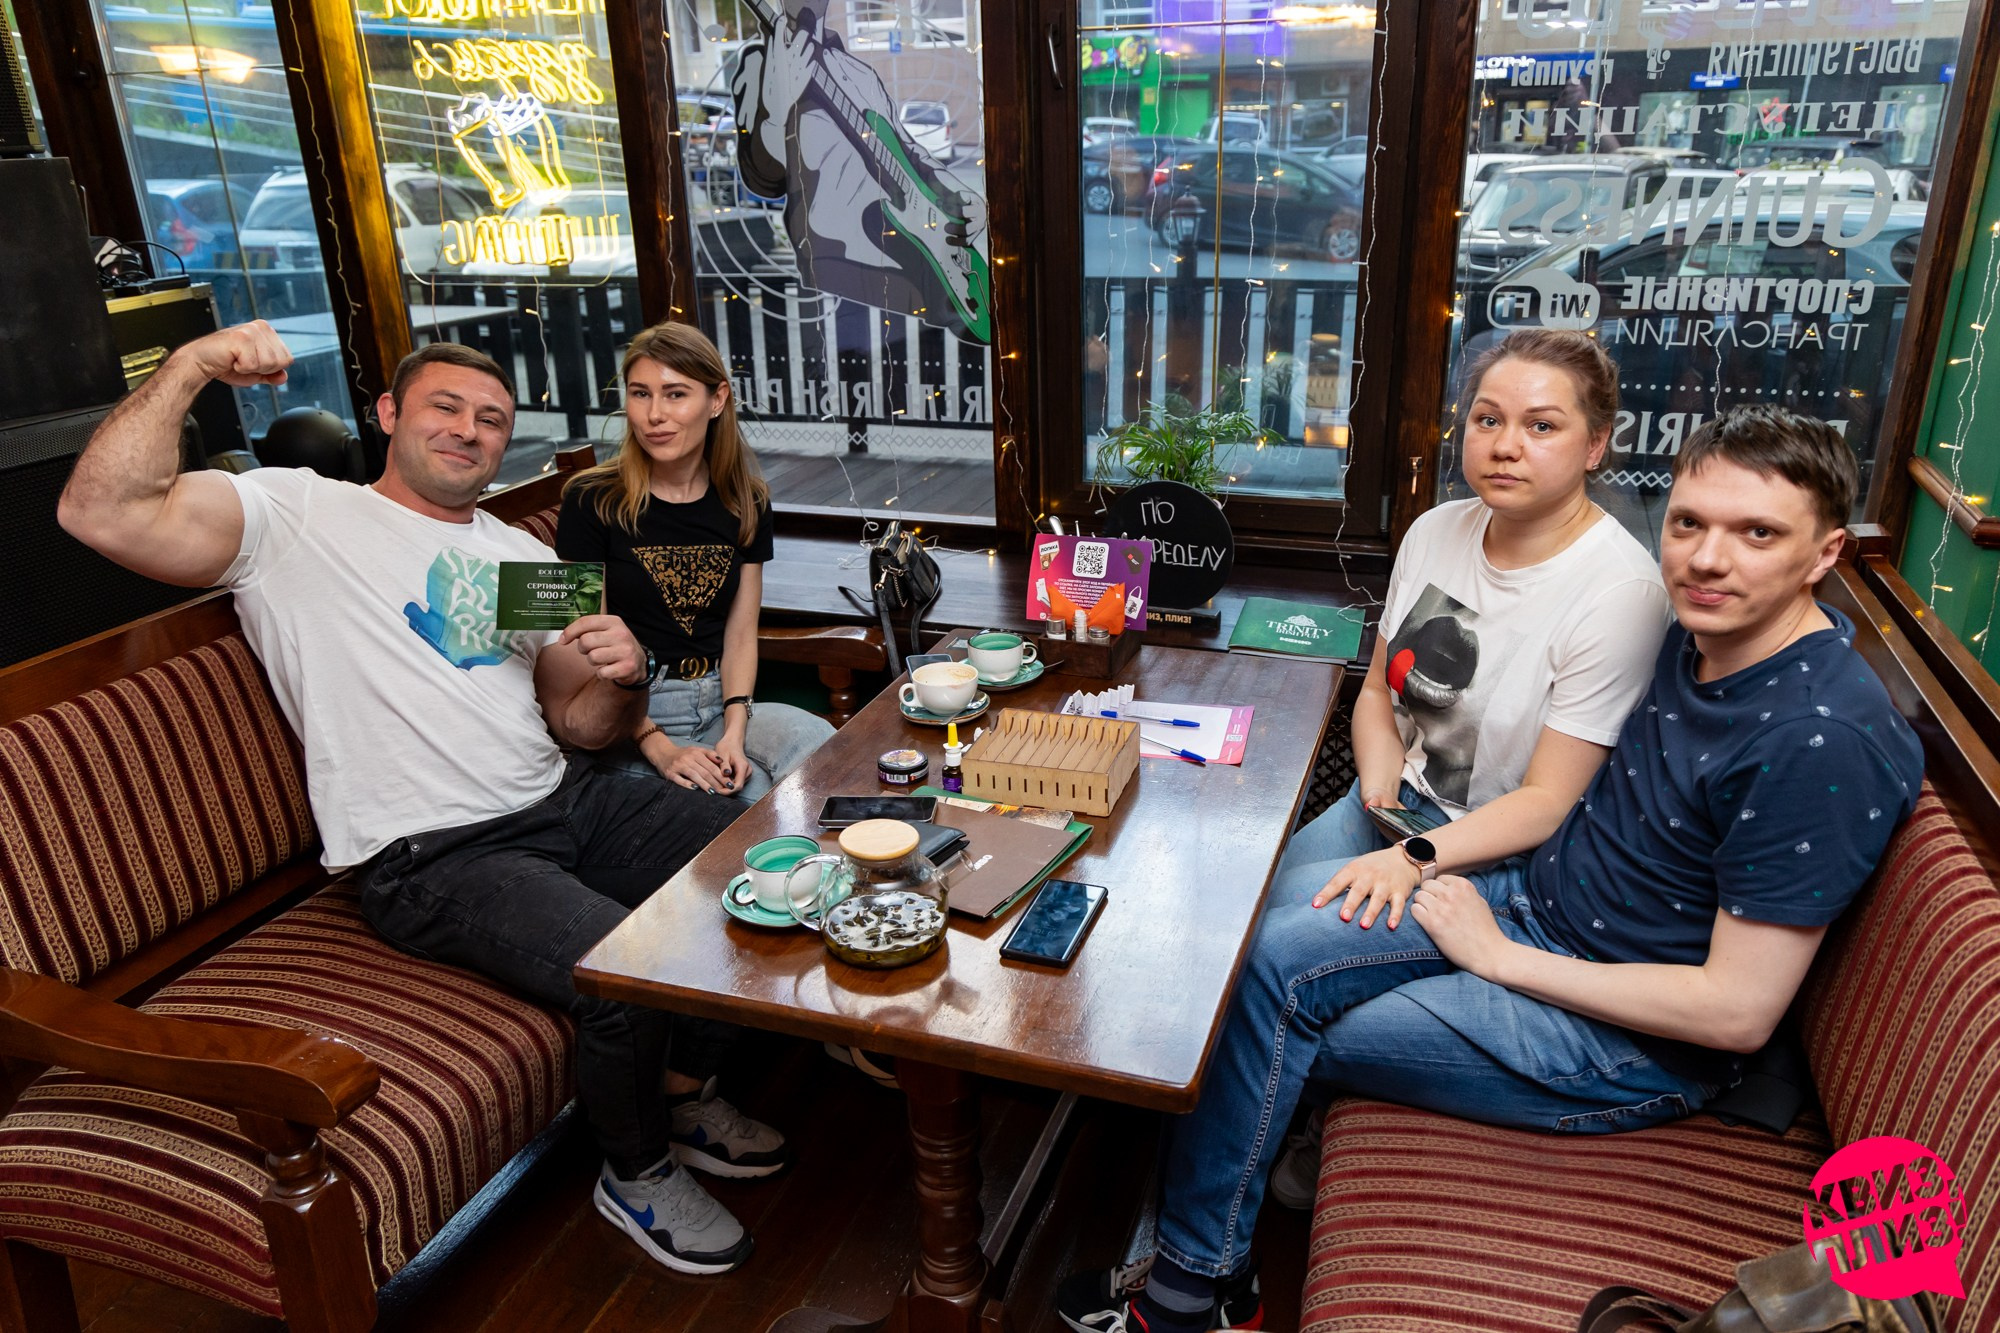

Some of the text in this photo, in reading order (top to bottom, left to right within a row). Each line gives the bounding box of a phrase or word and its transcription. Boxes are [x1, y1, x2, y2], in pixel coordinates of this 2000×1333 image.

[1140, 500, 1175, 526] ПО
[526, 582, 577, 590] СЕРТИФИКАТ
[536, 591, 559, 599] 1000
[1165, 614, 1192, 624] ПЛИЗ!
[1266, 620, 1334, 637] TRINITY
